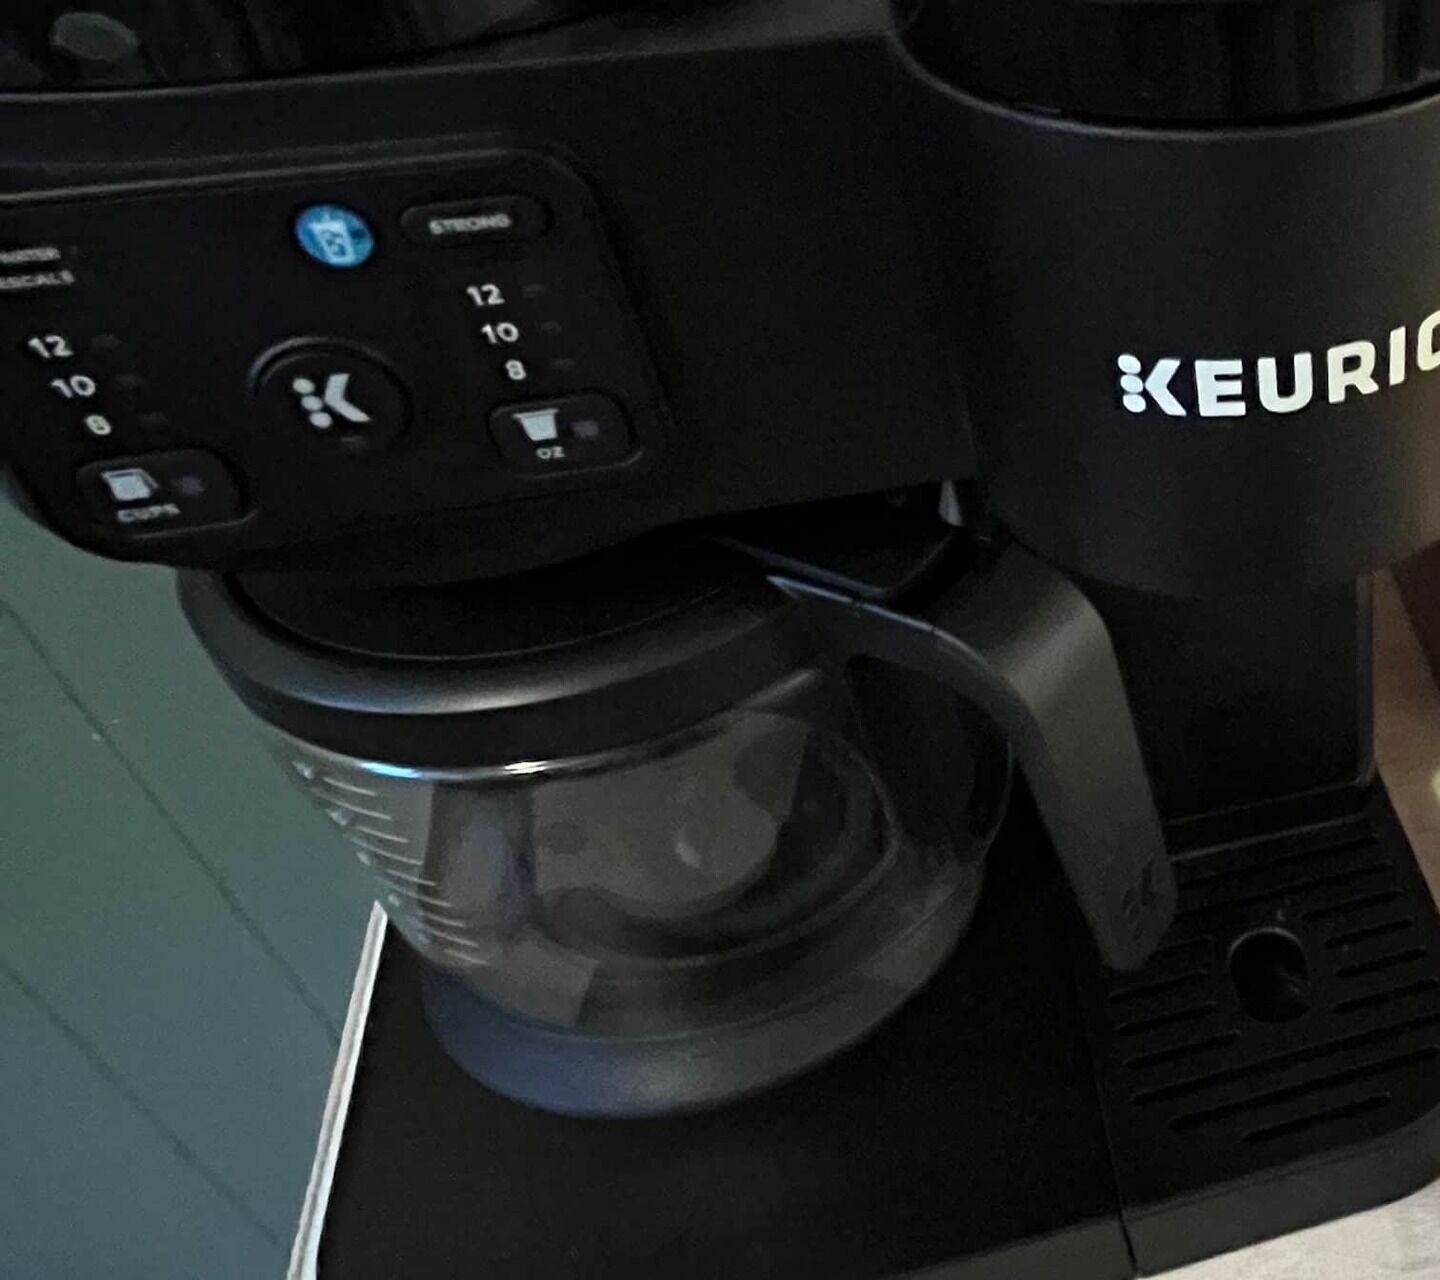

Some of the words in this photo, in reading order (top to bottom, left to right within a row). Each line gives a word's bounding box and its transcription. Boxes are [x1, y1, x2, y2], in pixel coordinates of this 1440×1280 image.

[467, 283, 505, 307] 12
[481, 322, 520, 344] 10
[27, 335, 74, 359] 12
[505, 359, 527, 381] 8
[51, 375, 96, 399] 10
[85, 414, 112, 435] 8
